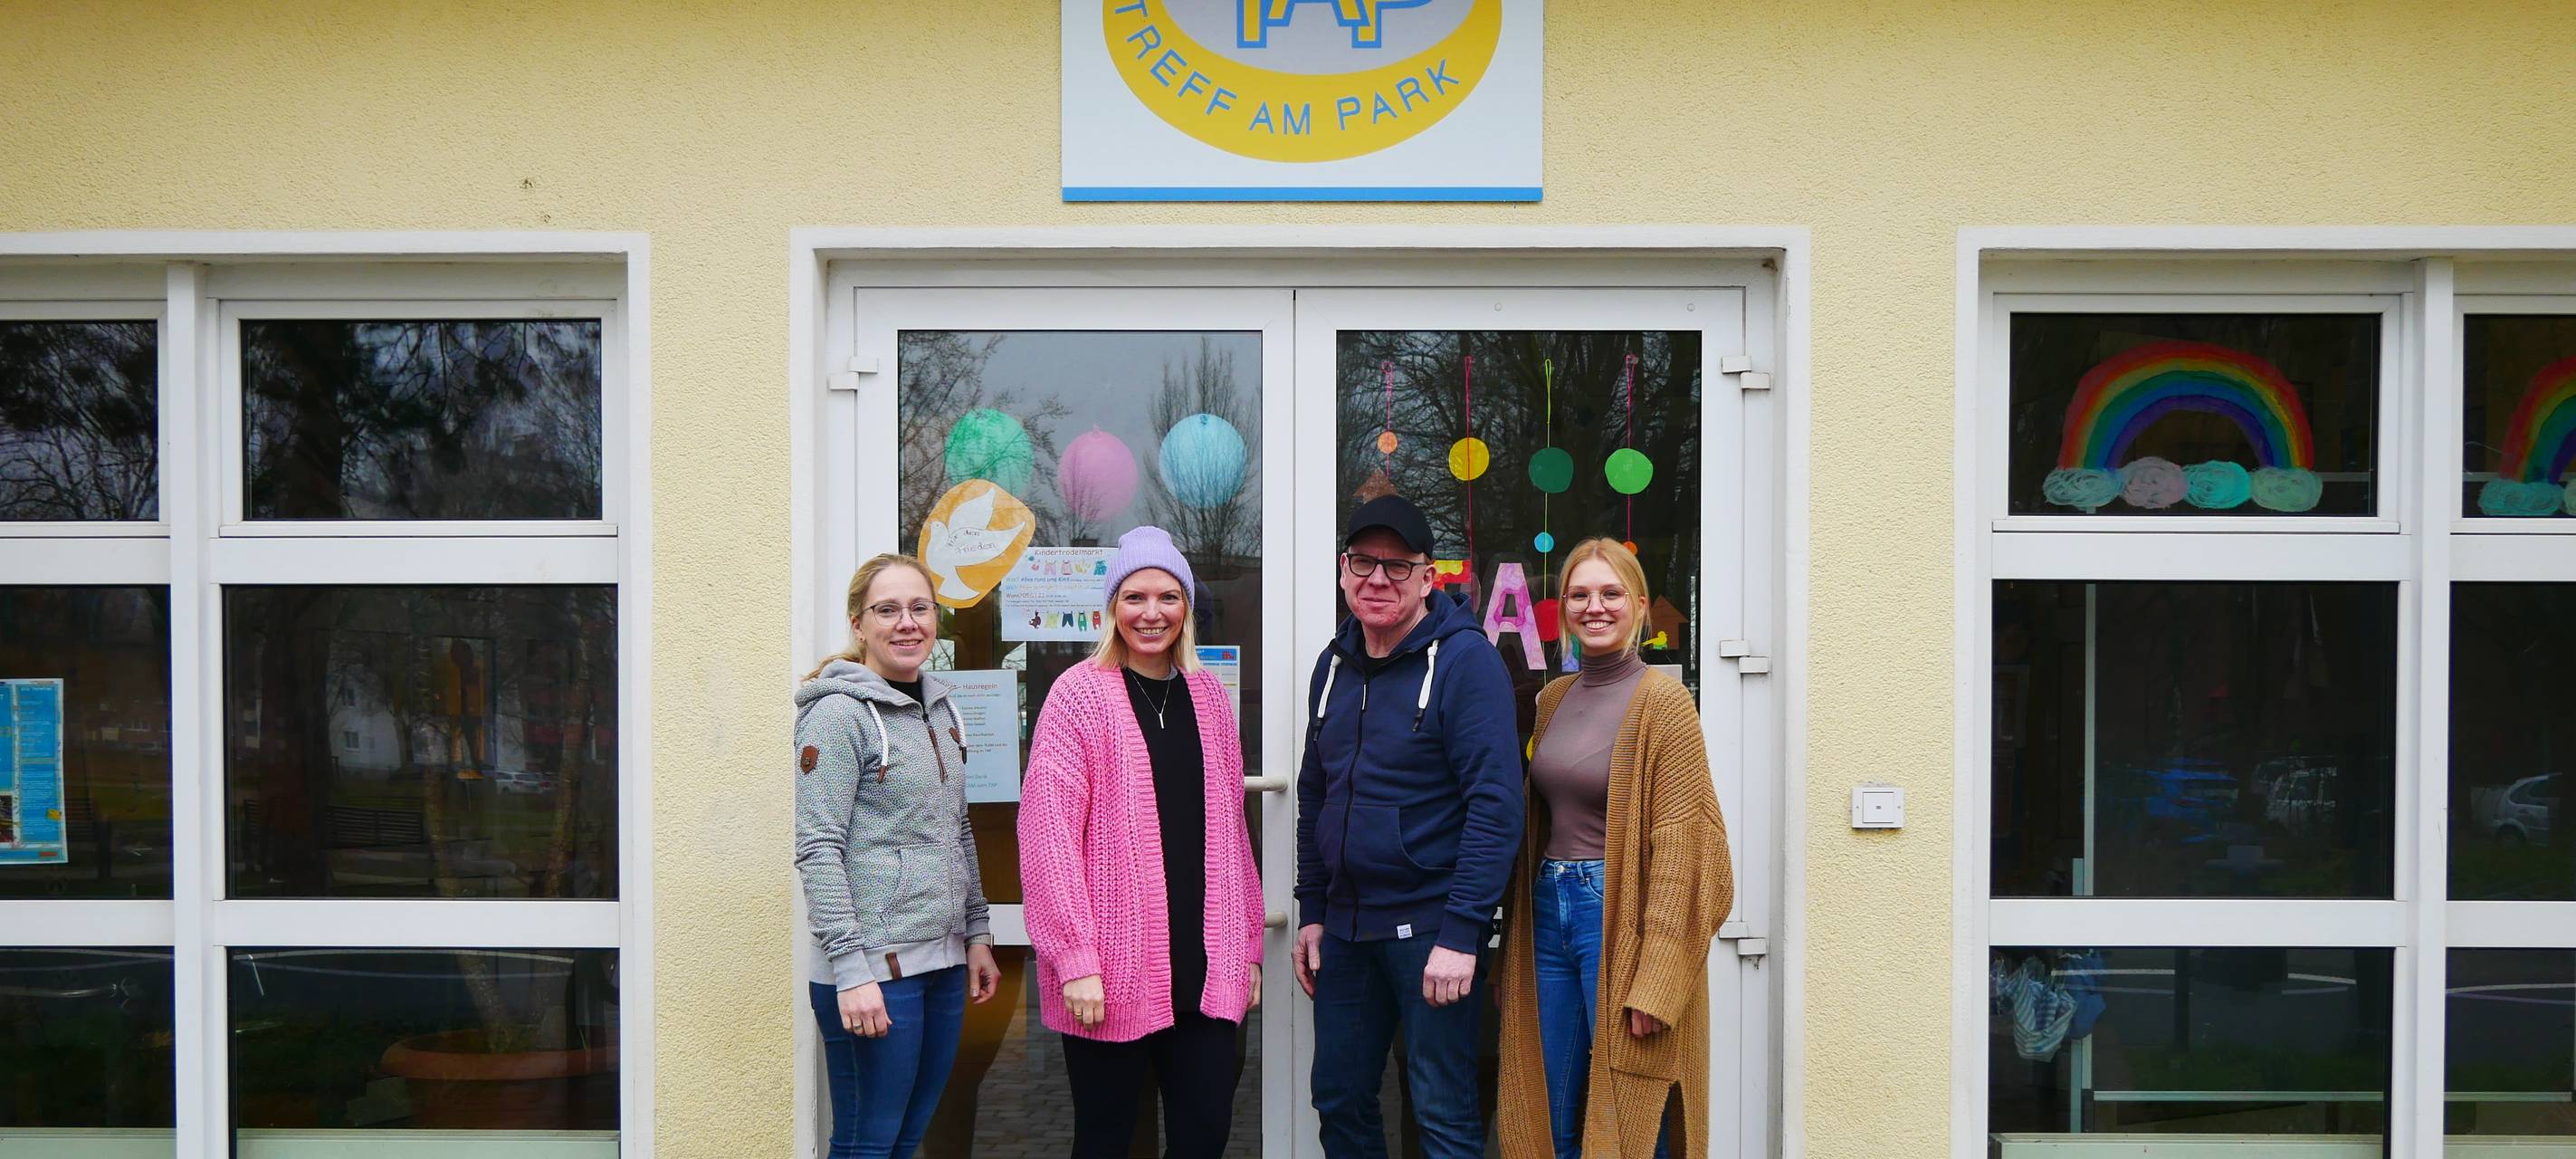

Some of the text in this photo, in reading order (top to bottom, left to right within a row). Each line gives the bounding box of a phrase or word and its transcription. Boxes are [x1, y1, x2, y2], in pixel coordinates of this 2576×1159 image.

[1114, 0, 1460, 135] TREFF AM PARK
[962, 683, 998, 691] Hausregeln
